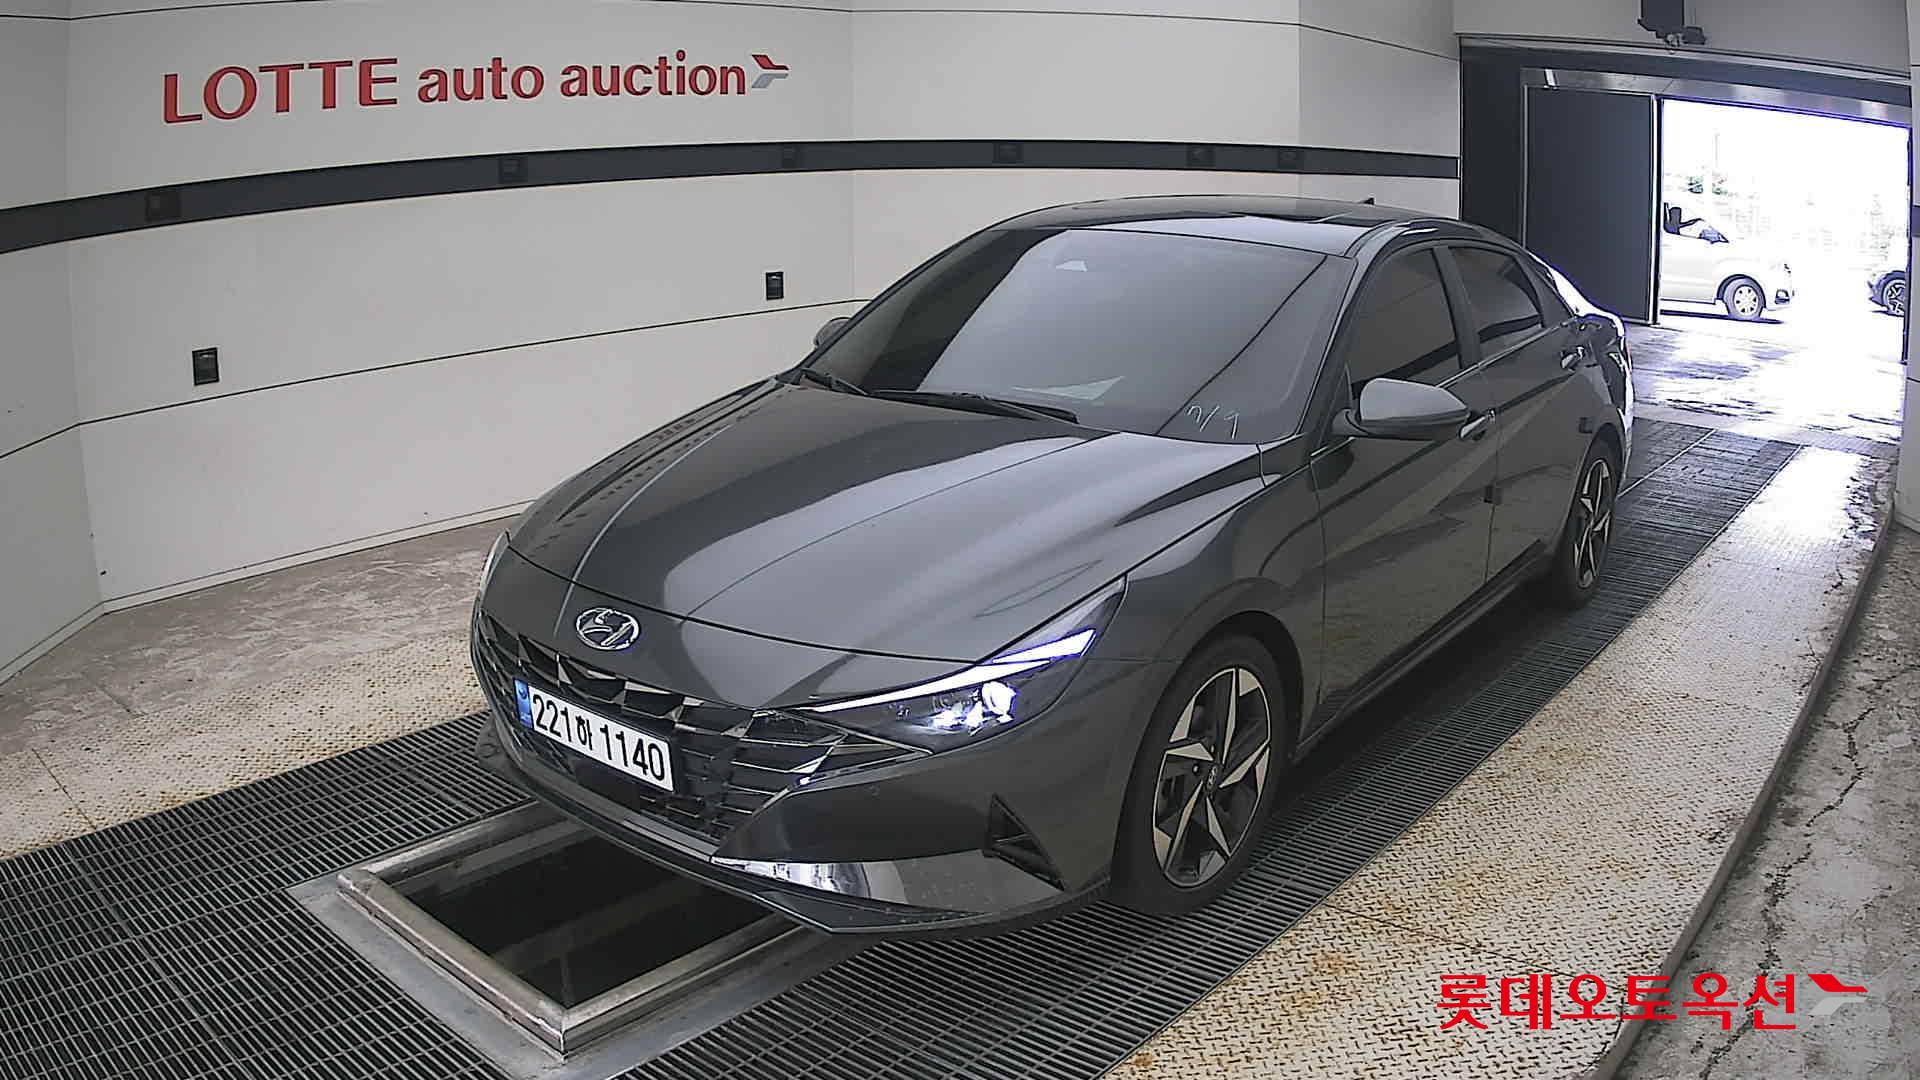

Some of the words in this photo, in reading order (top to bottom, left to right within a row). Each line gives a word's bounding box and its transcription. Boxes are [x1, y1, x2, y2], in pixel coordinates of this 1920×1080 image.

[163, 57, 399, 125] LOTTE
[417, 56, 545, 103] auto
[560, 50, 747, 97] auction
[599, 723, 666, 782] 1140
